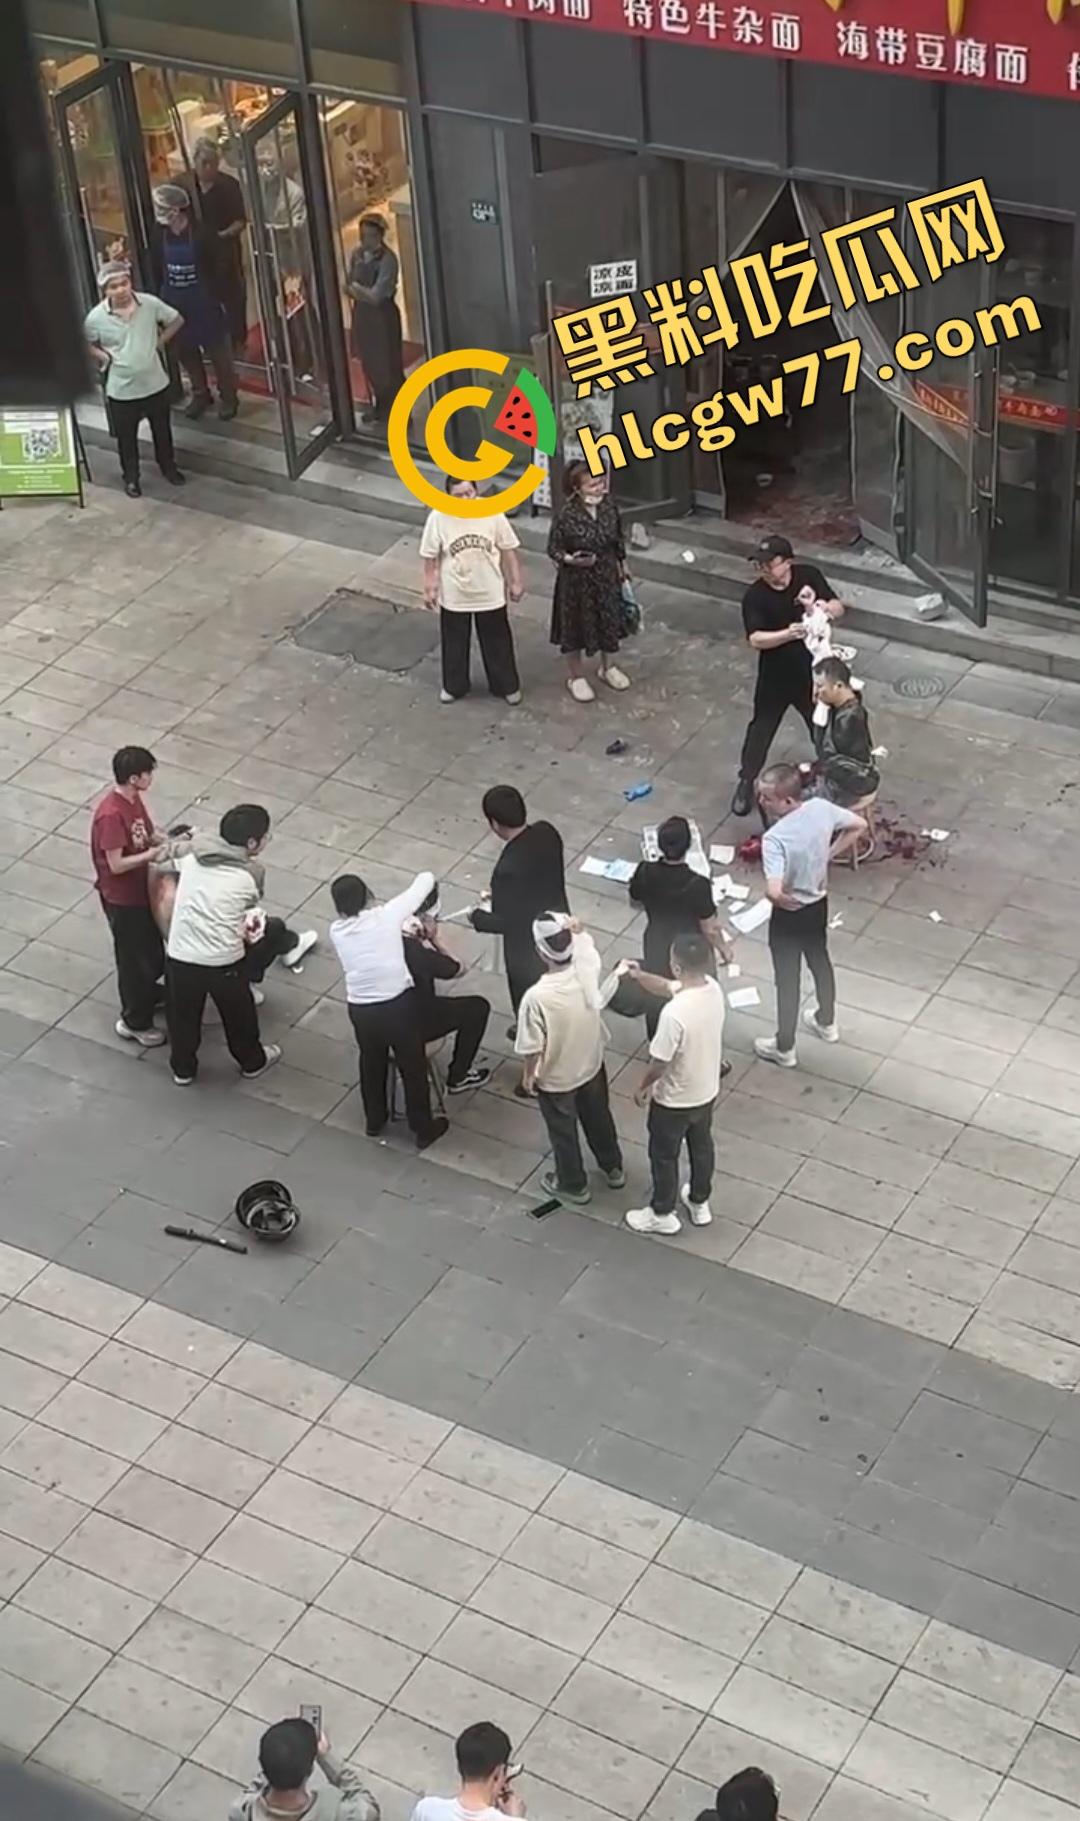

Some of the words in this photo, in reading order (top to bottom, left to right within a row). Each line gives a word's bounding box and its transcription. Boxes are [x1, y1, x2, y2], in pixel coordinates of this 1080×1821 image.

[624, 0, 800, 51] 特色牛杂面
[836, 21, 1028, 84] 海带豆腐面
